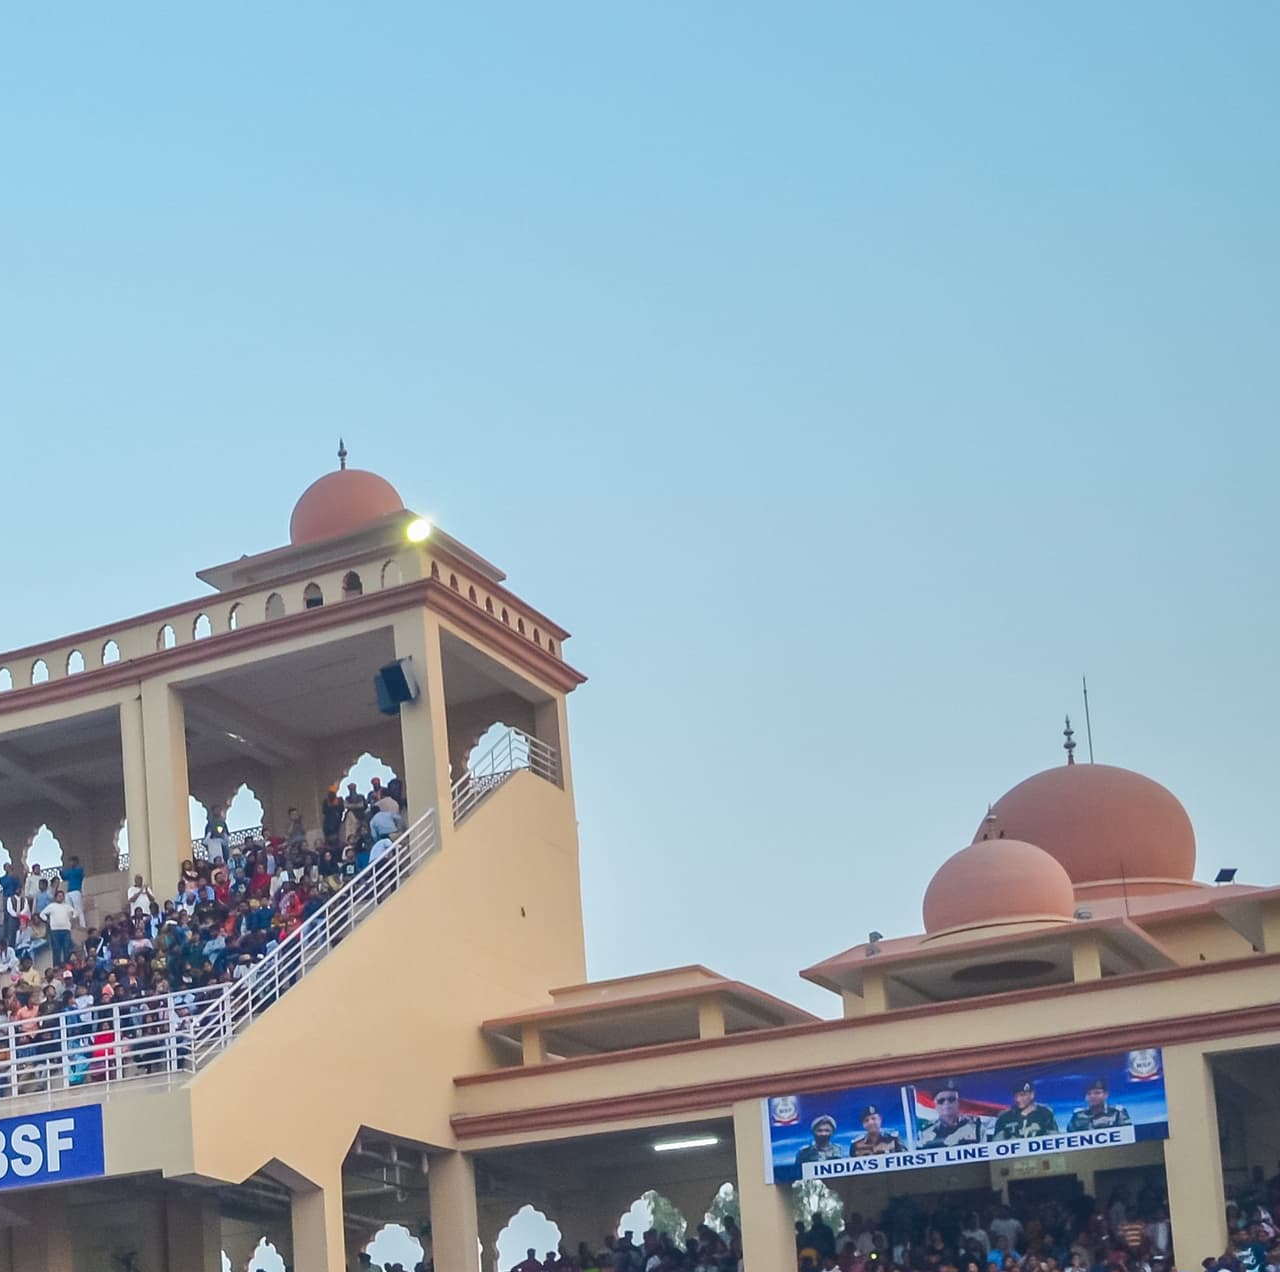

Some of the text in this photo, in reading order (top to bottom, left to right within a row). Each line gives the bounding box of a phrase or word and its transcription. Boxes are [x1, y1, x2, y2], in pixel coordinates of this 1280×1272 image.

[813, 1130, 1122, 1176] INDIA'S FIRST LINE OF DEFENCE
